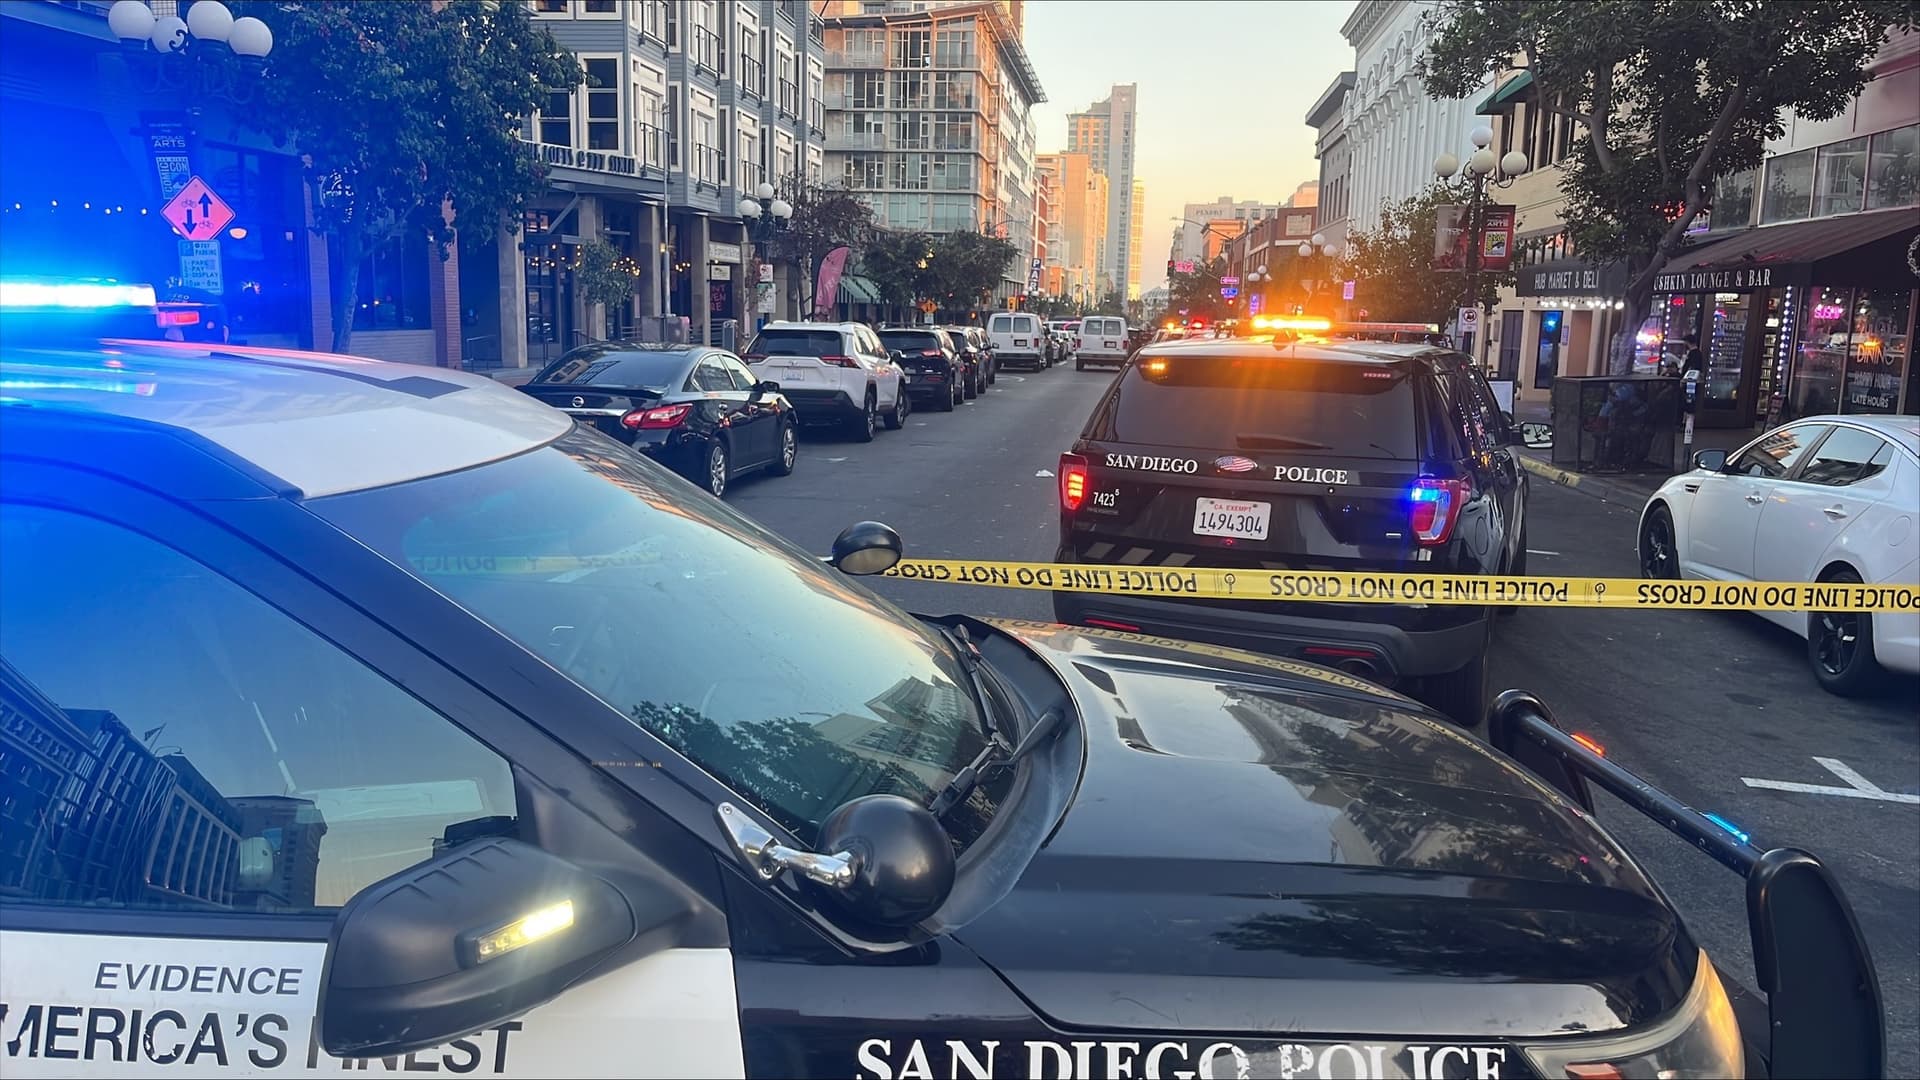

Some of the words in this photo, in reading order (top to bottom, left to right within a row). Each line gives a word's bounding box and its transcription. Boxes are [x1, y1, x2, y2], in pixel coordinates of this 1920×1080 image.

[153, 139, 186, 148] ARTS
[169, 162, 188, 173] CON
[1534, 272, 1546, 290] HUB
[1548, 271, 1572, 290] MARKET
[1574, 271, 1580, 289] &
[1583, 270, 1600, 289] DELI
[1691, 272, 1729, 289] LOUNGE
[1735, 270, 1742, 287] &
[1748, 268, 1771, 287] BAR
[1851, 393, 1867, 405] LATE
[1867, 395, 1889, 408] HOURS
[1105, 453, 1139, 470] SAN
[1140, 456, 1199, 475] DIEGO
[1273, 465, 1349, 485] POLICE
[1225, 504, 1254, 513] EXEMPT
[1198, 511, 1263, 534] 1494304
[886, 564, 951, 580] CROS
[957, 565, 1011, 584] NOT
[1016, 566, 1054, 586] DO
[1060, 568, 1113, 590] LINE
[1118, 569, 1197, 593] POLICE
[1269, 574, 1342, 598] CROSS
[1347, 576, 1395, 599] NOT
[1401, 577, 1434, 600] DO
[1441, 579, 1489, 601] LINE
[1494, 580, 1570, 603] POLICE
[1637, 583, 1707, 605] CROSS
[1711, 585, 1758, 606] NOT
[1763, 586, 1796, 607] DO
[1802, 587, 1850, 608] LINE
[94, 961, 303, 996] EVIDENCE
[856, 1038, 1000, 1079] SAN
[1023, 1040, 1252, 1079] DIEGO
